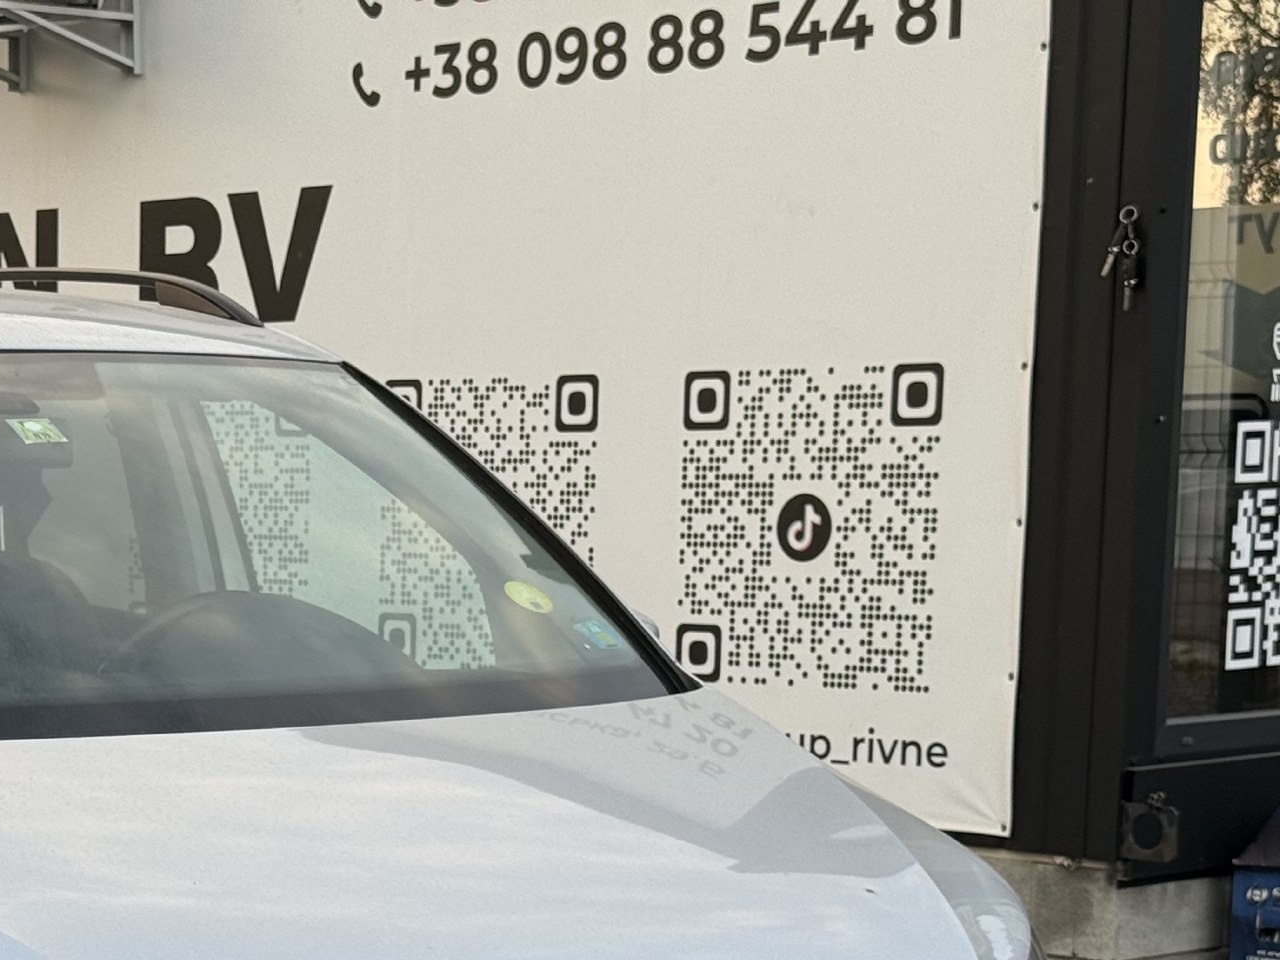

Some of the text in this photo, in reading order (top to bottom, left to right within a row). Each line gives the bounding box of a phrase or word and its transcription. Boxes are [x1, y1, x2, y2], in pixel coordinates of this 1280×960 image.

[404, 0, 961, 99] +38 098 88 544 81
